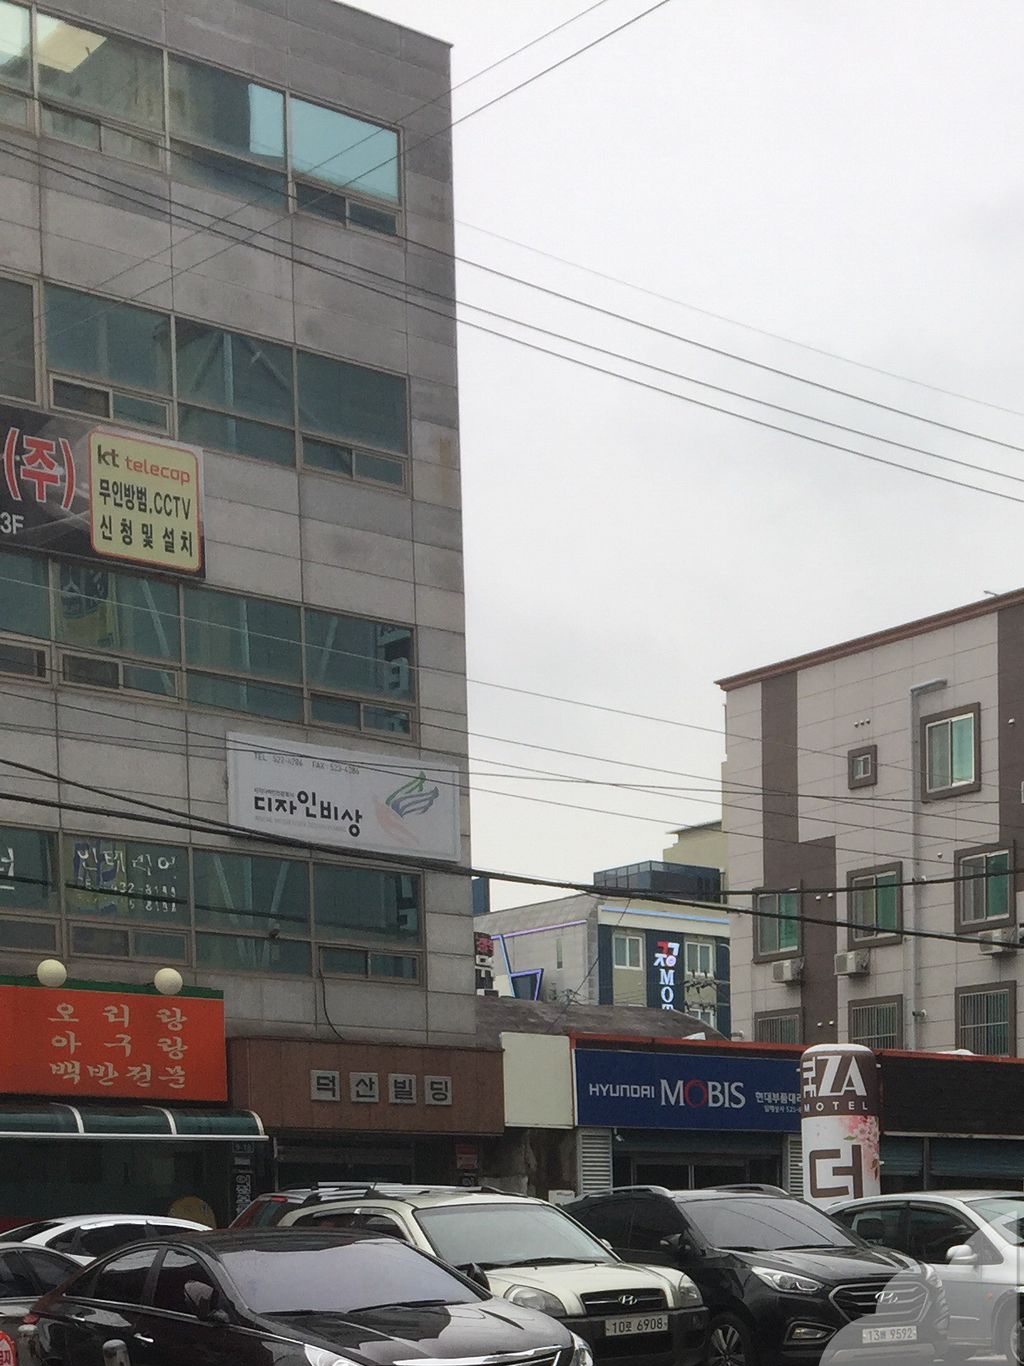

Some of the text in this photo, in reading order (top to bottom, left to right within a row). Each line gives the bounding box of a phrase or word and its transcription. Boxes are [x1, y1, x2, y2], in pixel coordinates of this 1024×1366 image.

[3, 426, 77, 512] (주)
[97, 444, 120, 468] kt
[0, 511, 24, 535] 3F
[253, 790, 364, 838] 디자인비상
[48, 1002, 188, 1031] 오리랑
[50, 1060, 186, 1089] 백반전문
[316, 1075, 450, 1102] 덕산빌딩
[588, 1077, 747, 1109] HYUNDAI MOBIS
[803, 1100, 868, 1113] MOTEL
